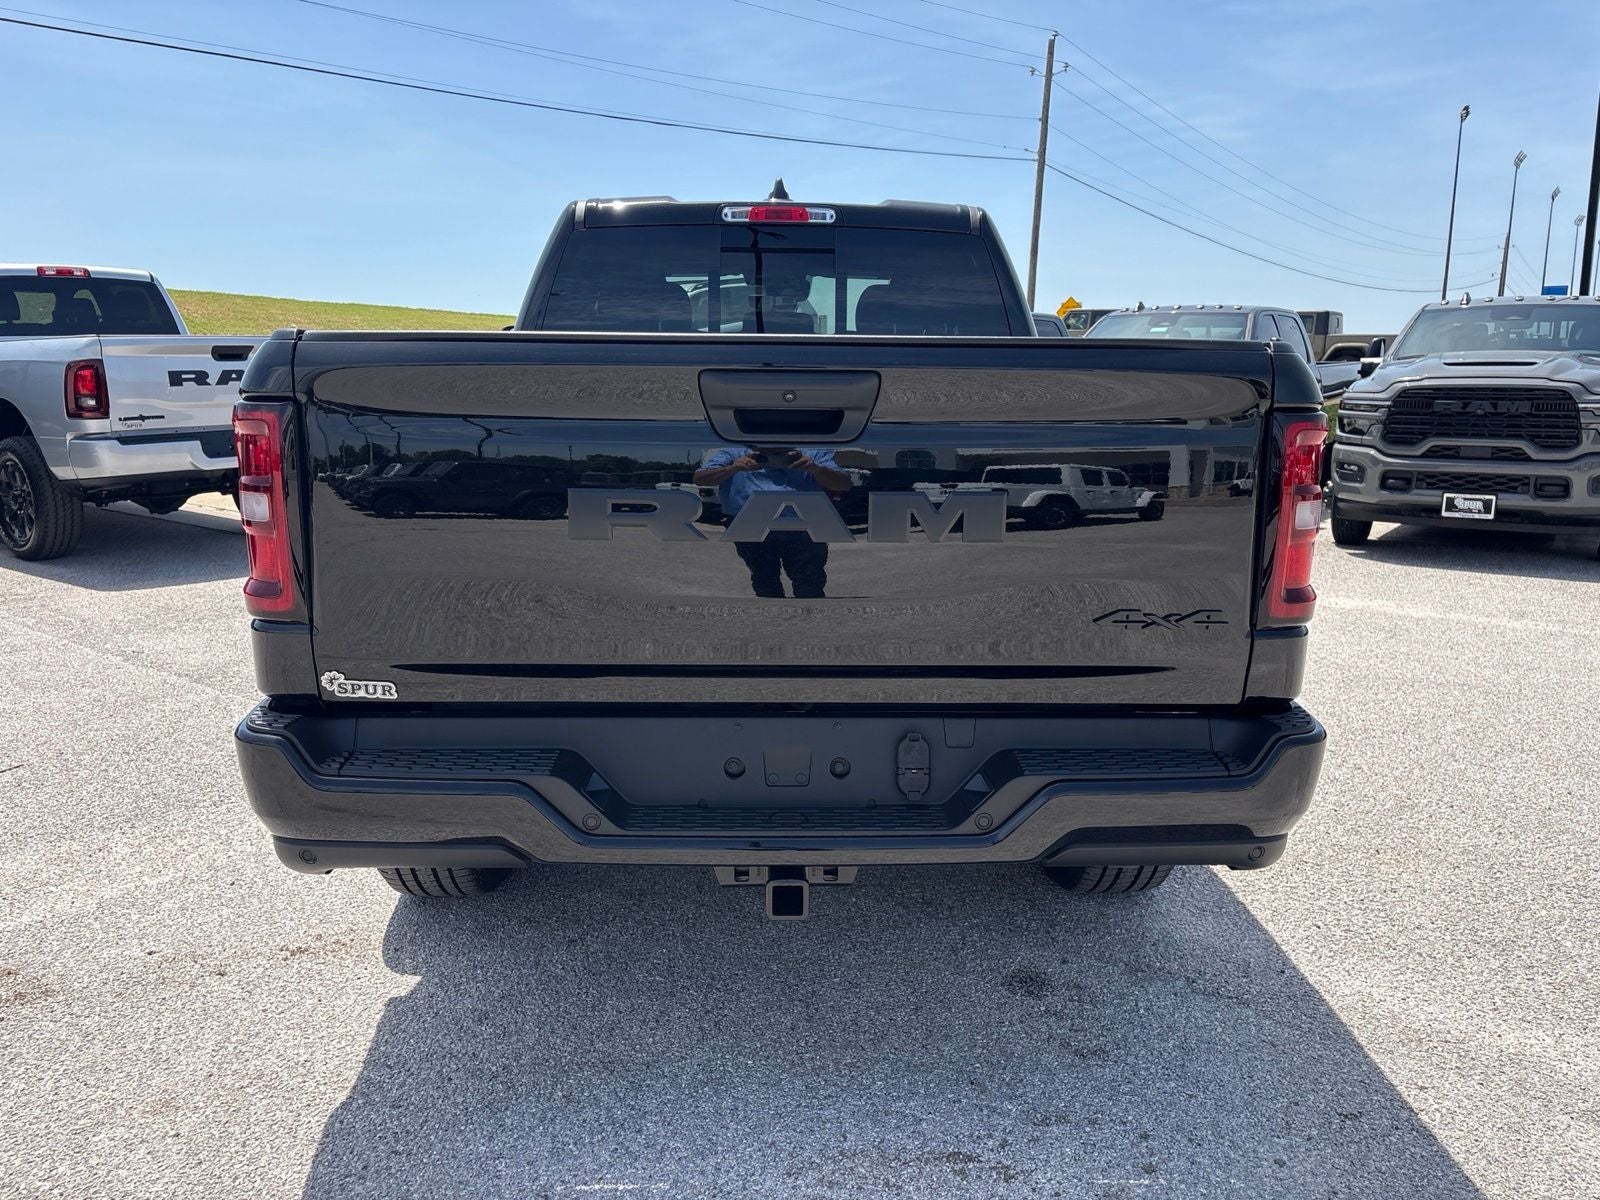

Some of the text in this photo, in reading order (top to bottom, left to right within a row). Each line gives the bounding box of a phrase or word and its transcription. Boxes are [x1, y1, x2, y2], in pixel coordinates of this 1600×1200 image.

[168, 370, 245, 387] RA
[1433, 400, 1531, 412] RAM
[1459, 500, 1483, 510] SPUR
[567, 487, 1007, 543] RAM
[337, 682, 394, 697] SPUR
